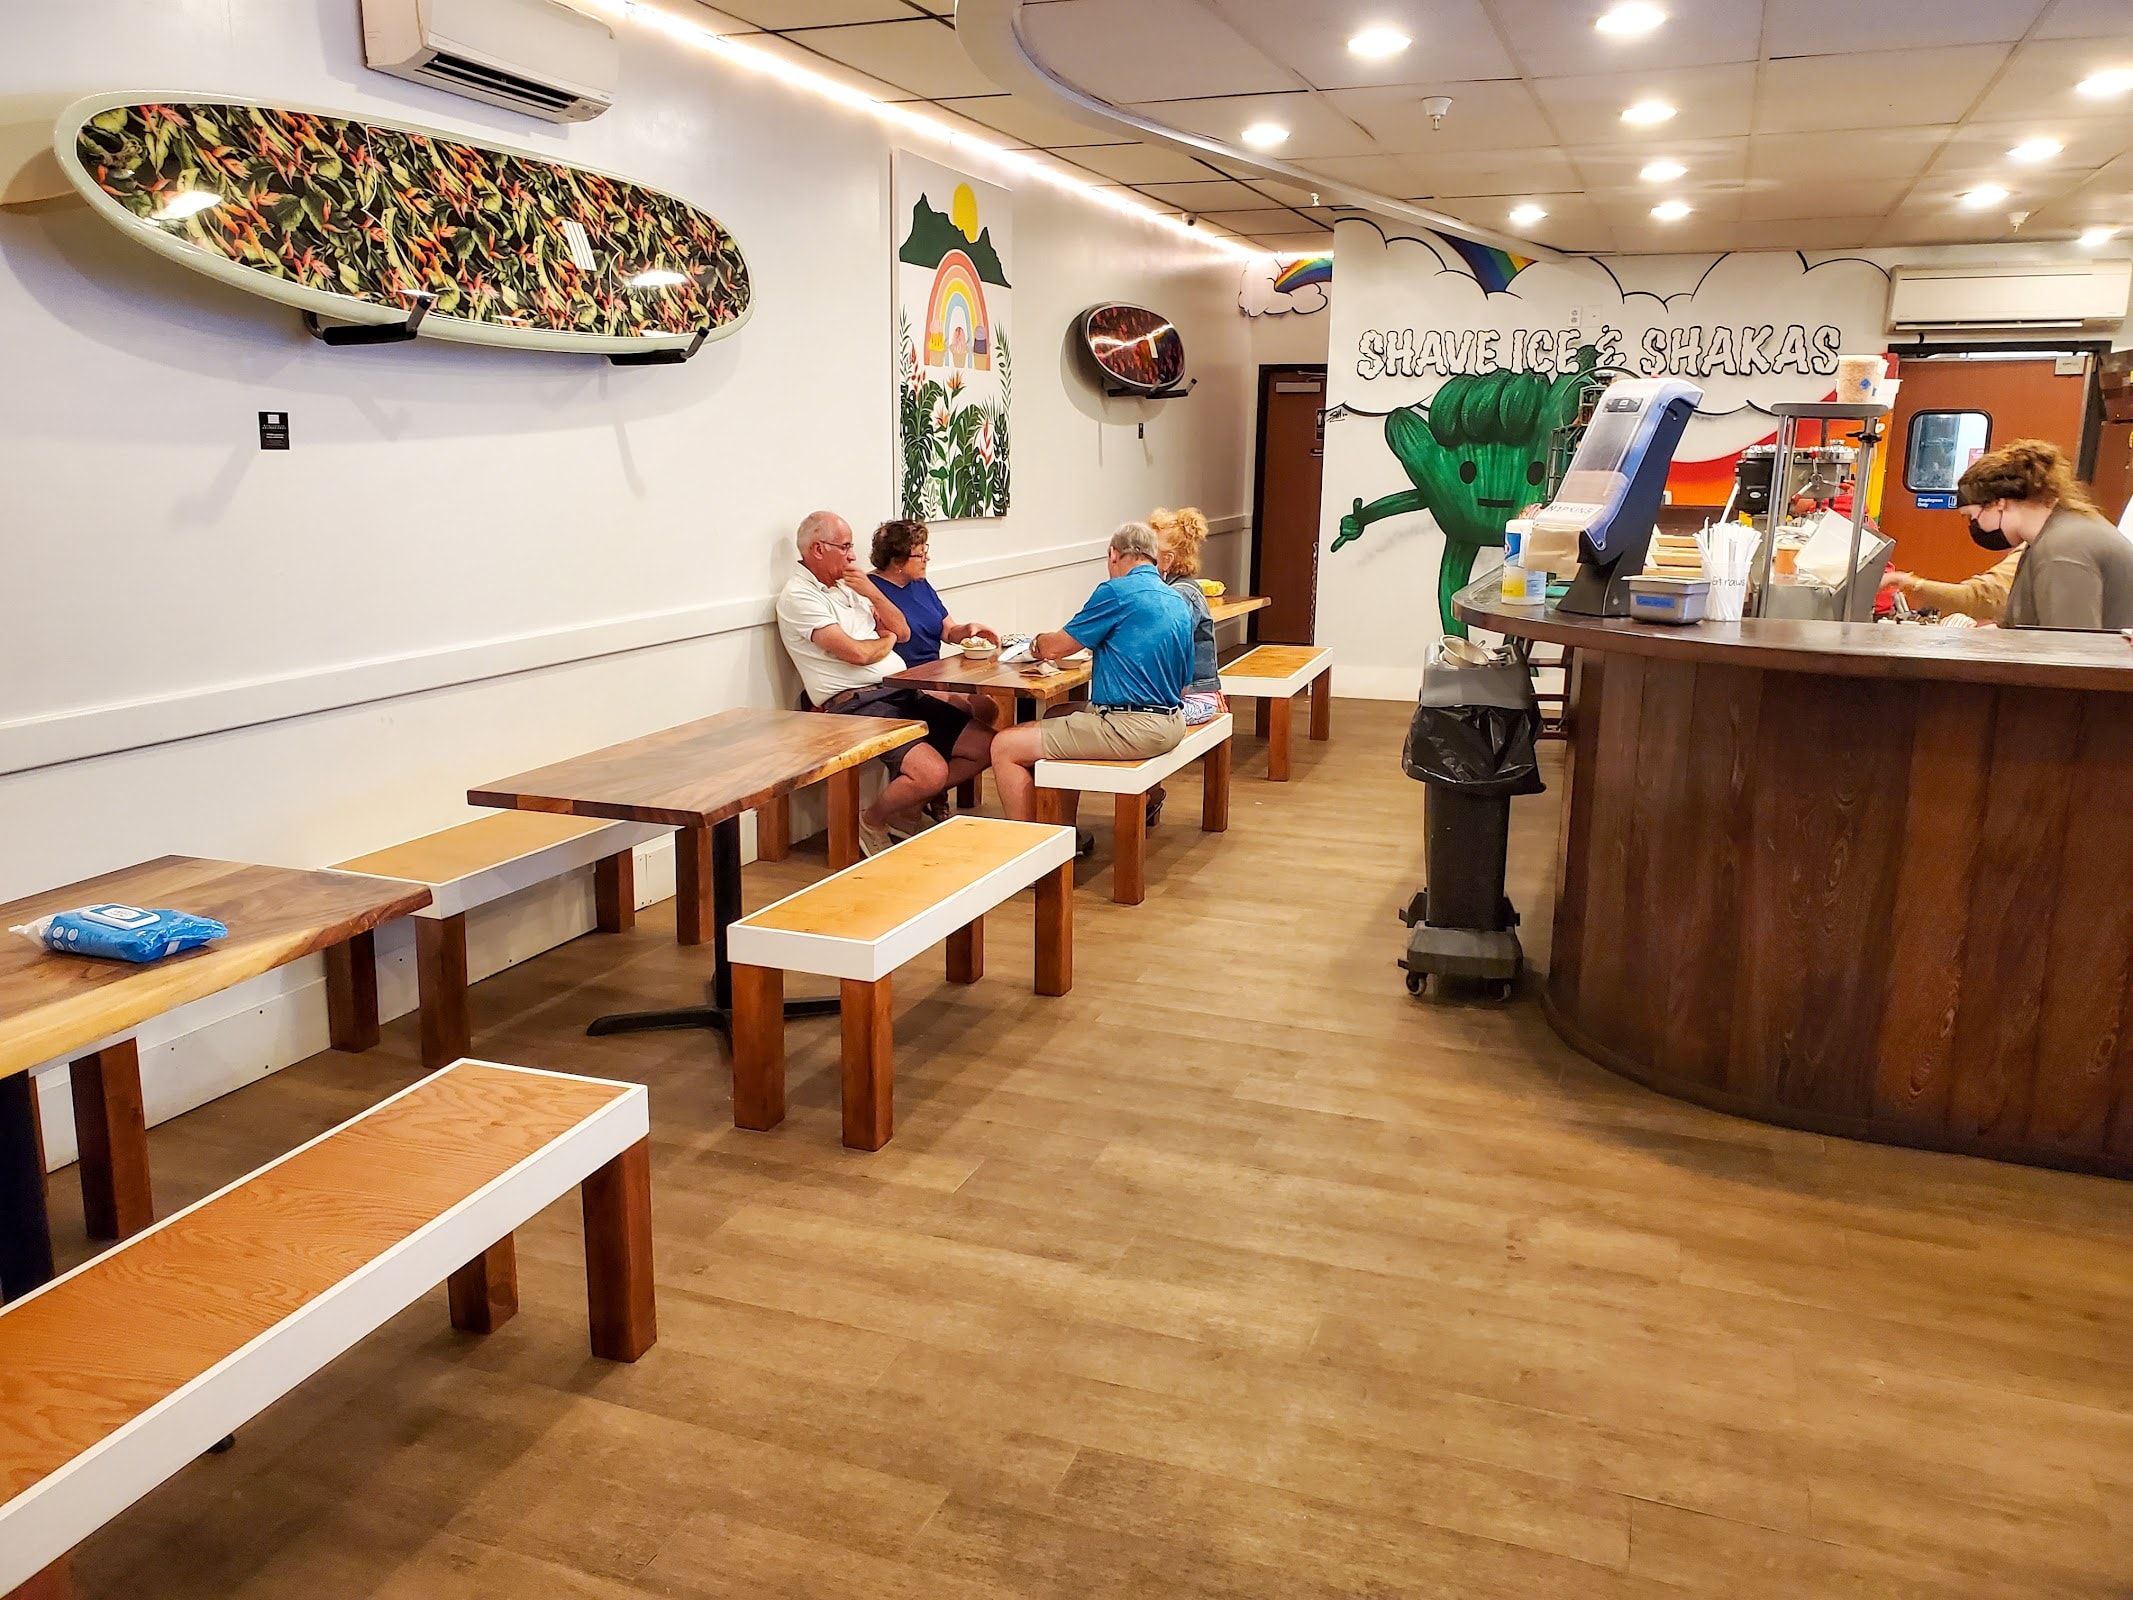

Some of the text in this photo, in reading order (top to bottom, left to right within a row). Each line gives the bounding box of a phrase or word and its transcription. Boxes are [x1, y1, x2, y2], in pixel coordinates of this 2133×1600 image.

[1357, 325, 1841, 380] SHAVE ICE & SHAKAS
[1711, 576, 1745, 587] Straws
